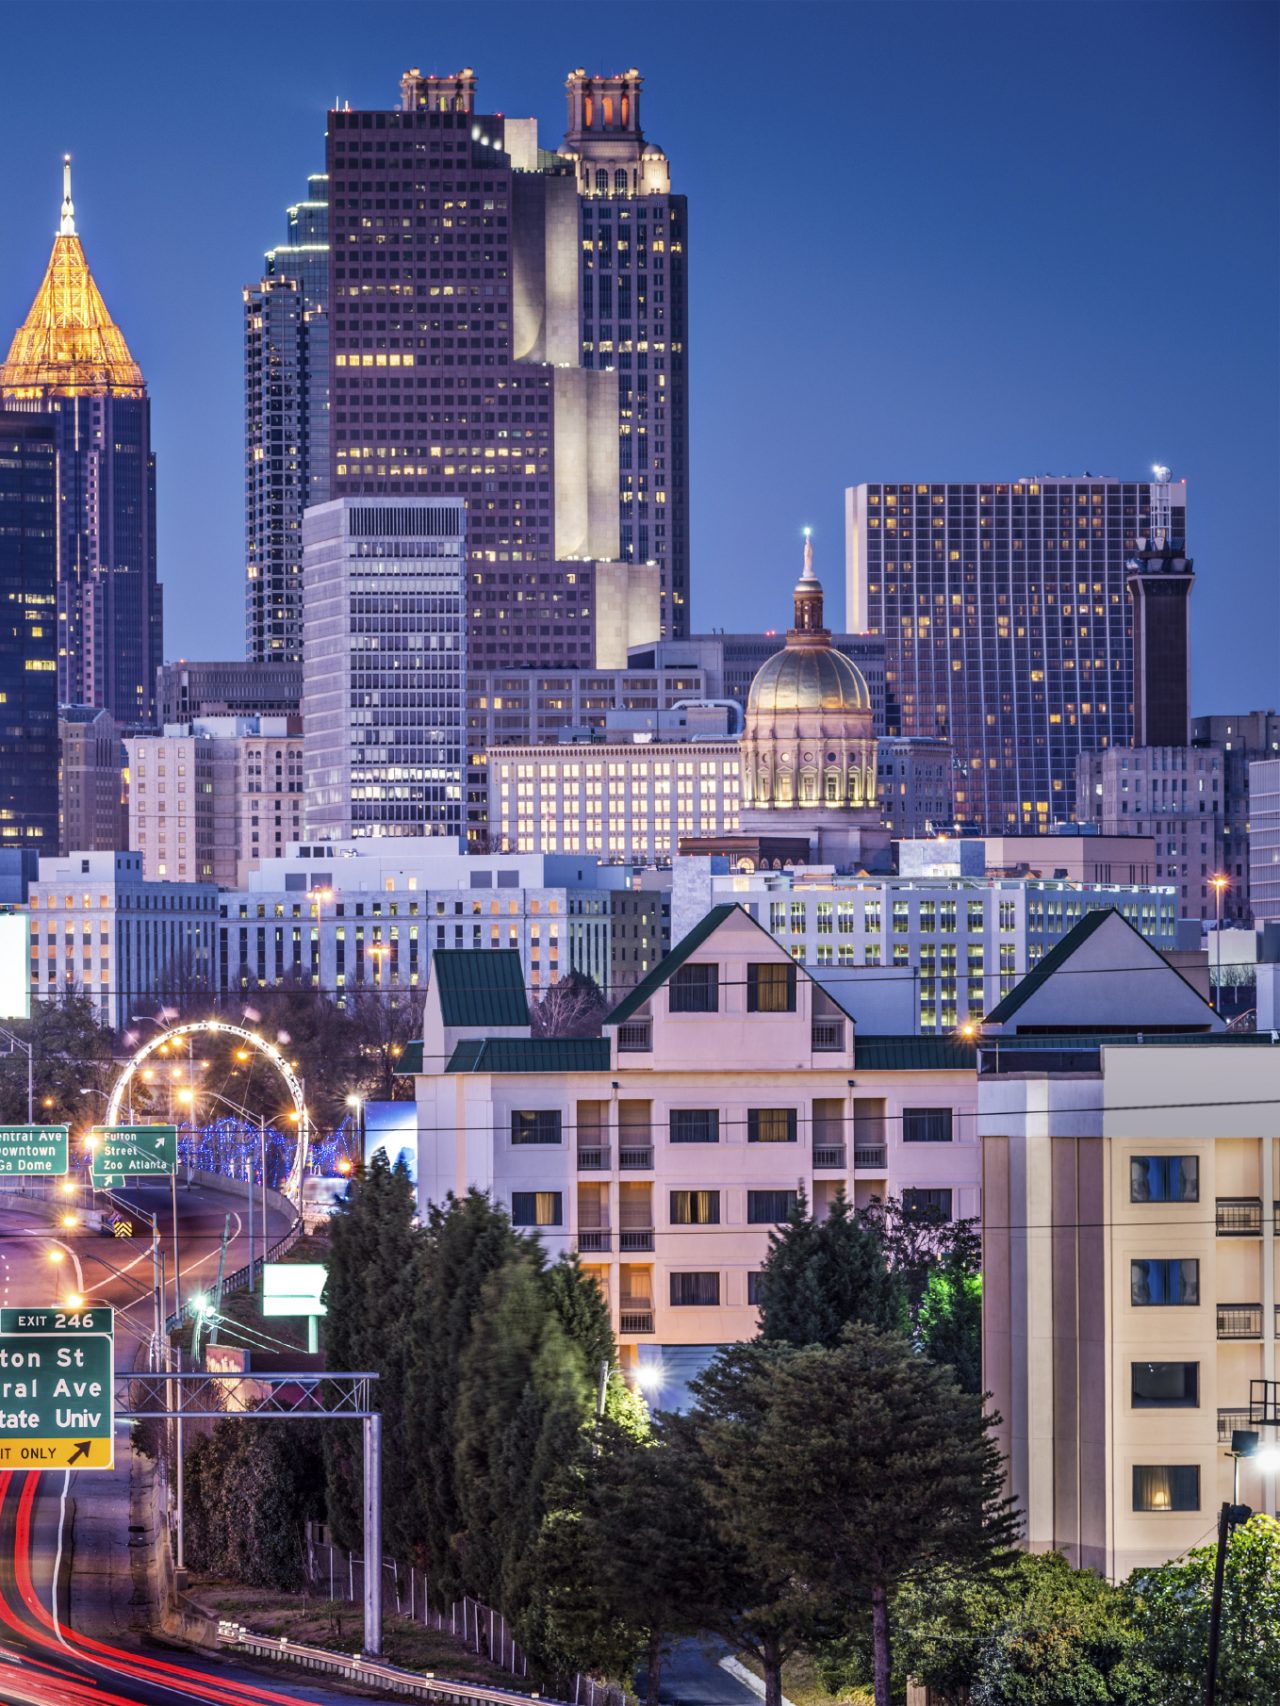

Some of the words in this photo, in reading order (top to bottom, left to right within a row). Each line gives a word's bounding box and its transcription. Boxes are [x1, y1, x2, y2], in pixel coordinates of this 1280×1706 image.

[36, 1131, 62, 1142] Ave
[104, 1133, 137, 1142] Fulton
[104, 1146, 138, 1156] Street
[18, 1159, 52, 1171] Dome
[103, 1160, 123, 1170] Zoo
[129, 1159, 167, 1170] Atlanta
[18, 1316, 47, 1326] EXIT
[54, 1314, 94, 1328] 246
[57, 1348, 84, 1368] St
[53, 1378, 102, 1398] Ave
[55, 1408, 102, 1429] Univ
[20, 1447, 57, 1460] ONLY
